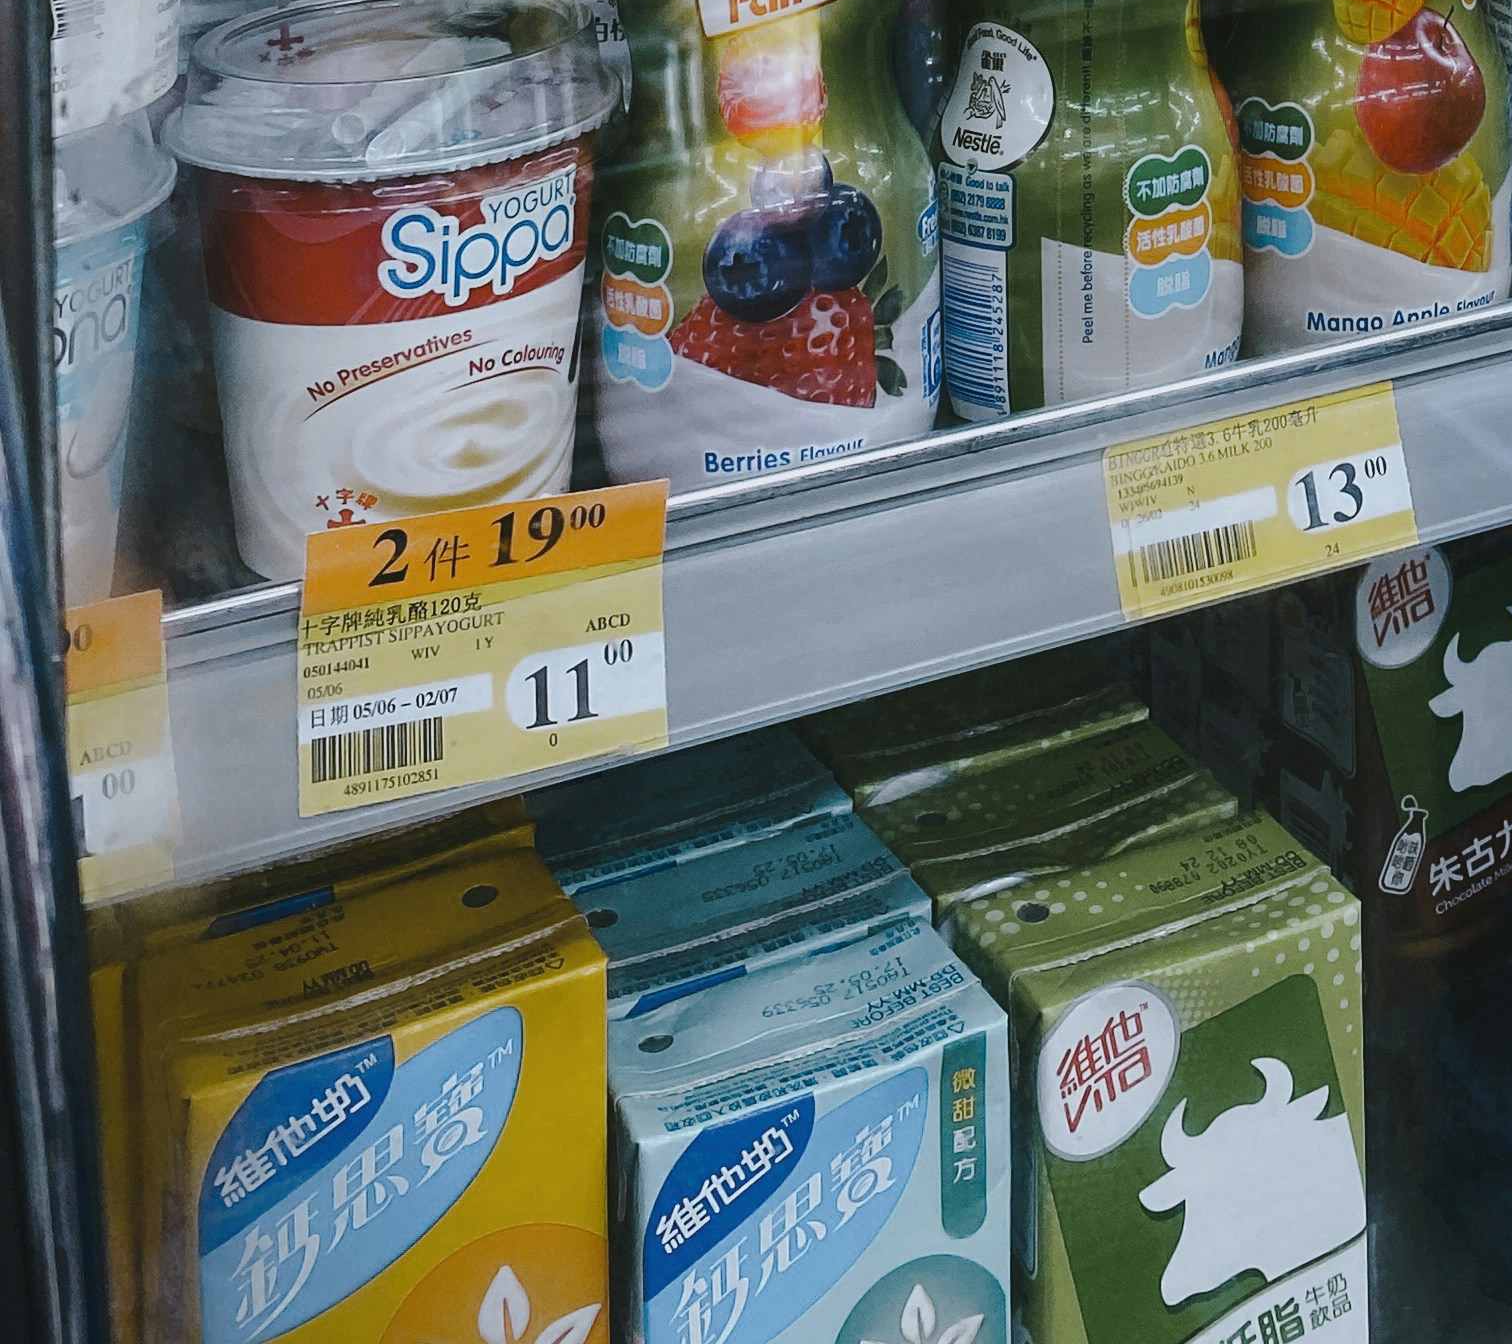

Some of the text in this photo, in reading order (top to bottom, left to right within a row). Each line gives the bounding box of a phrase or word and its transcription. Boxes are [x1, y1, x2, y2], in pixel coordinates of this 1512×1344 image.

[487, 171, 572, 222] YOGURT
[386, 212, 571, 301] Sippa
[1082, 249, 1095, 299] before
[467, 341, 567, 377] No Colouring
[1082, 321, 1095, 344] Peel
[306, 328, 472, 403] No Preservatives
[368, 529, 471, 588] 2 件
[303, 592, 483, 640] 十字牌純乳酪120克
[303, 612, 631, 679] 050144041 WIV ABCD
[343, 769, 439, 796] 4891175102851
[213, 1066, 373, 1209] 維他奶
[951, 1068, 978, 1183] 微甜配方
[228, 1073, 490, 1341] 鈣思寶
[655, 1126, 794, 1256] 維他奶
[668, 1131, 899, 1344] 鈣思寶
[1303, 1275, 1348, 1309] 牛奶
[1310, 1292, 1353, 1335] 飲品
